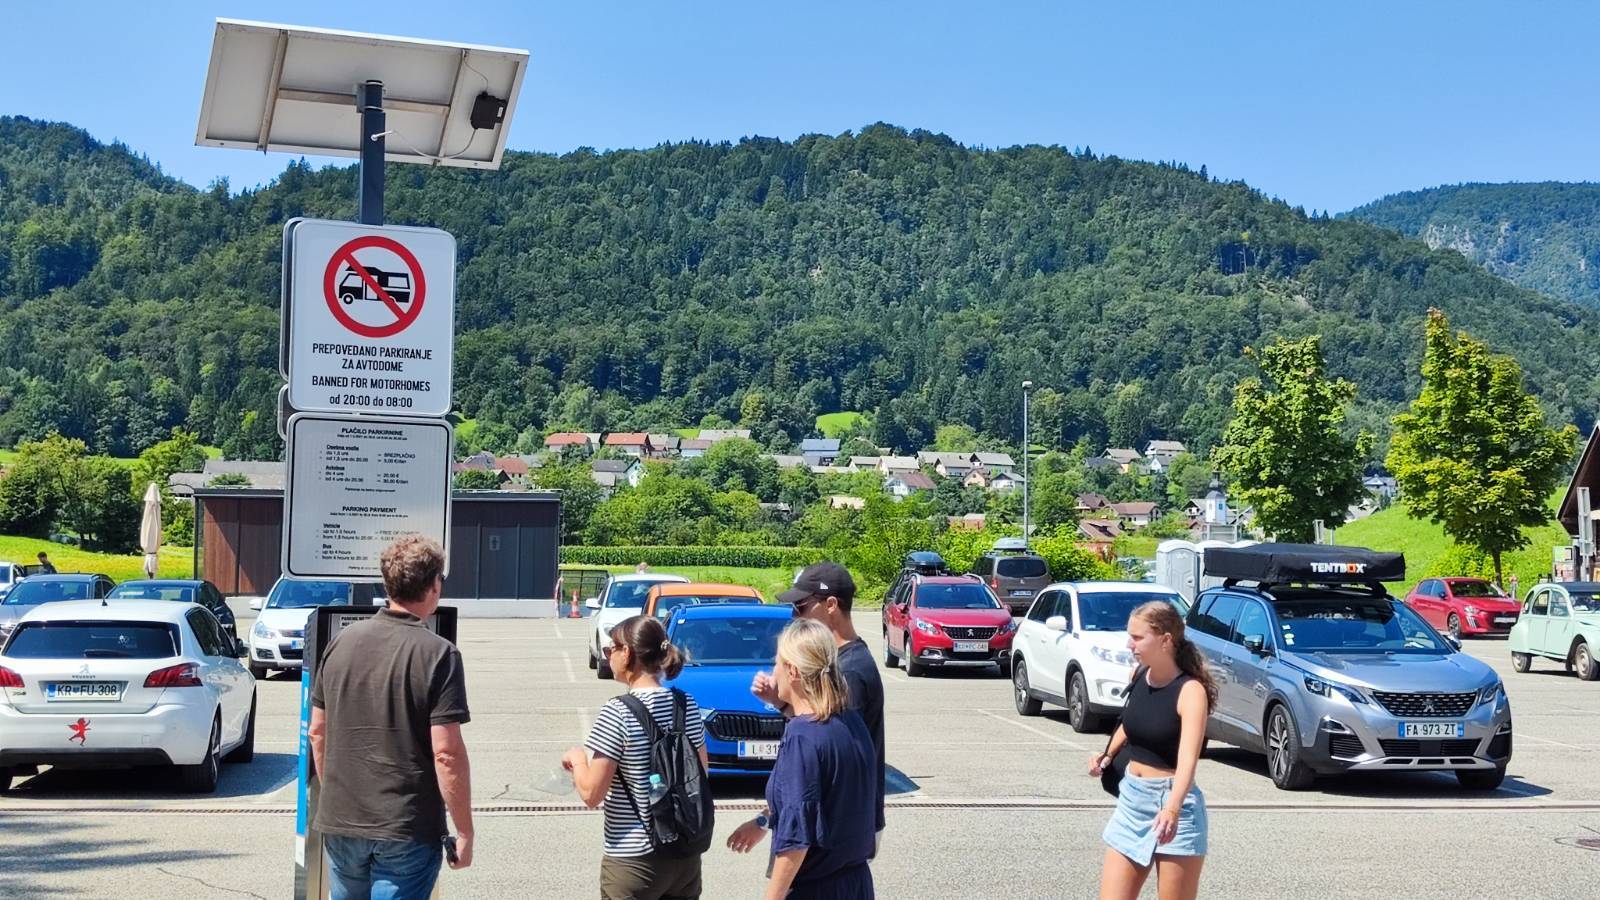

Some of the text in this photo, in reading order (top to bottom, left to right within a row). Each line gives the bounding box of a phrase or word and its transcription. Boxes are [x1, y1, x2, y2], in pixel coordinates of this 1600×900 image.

[312, 343, 432, 360] PREPOVEDANO PARKIRANJE
[342, 358, 404, 372] ZA AVTODOME
[312, 376, 430, 392] BANNED FOR MOTORHOMES
[330, 394, 412, 408] od 20:00 do 08:00
[1310, 562, 1364, 573] TENTBOX
[57, 685, 117, 696] KR FU-308
[1406, 724, 1456, 735] FA 973 ZT
